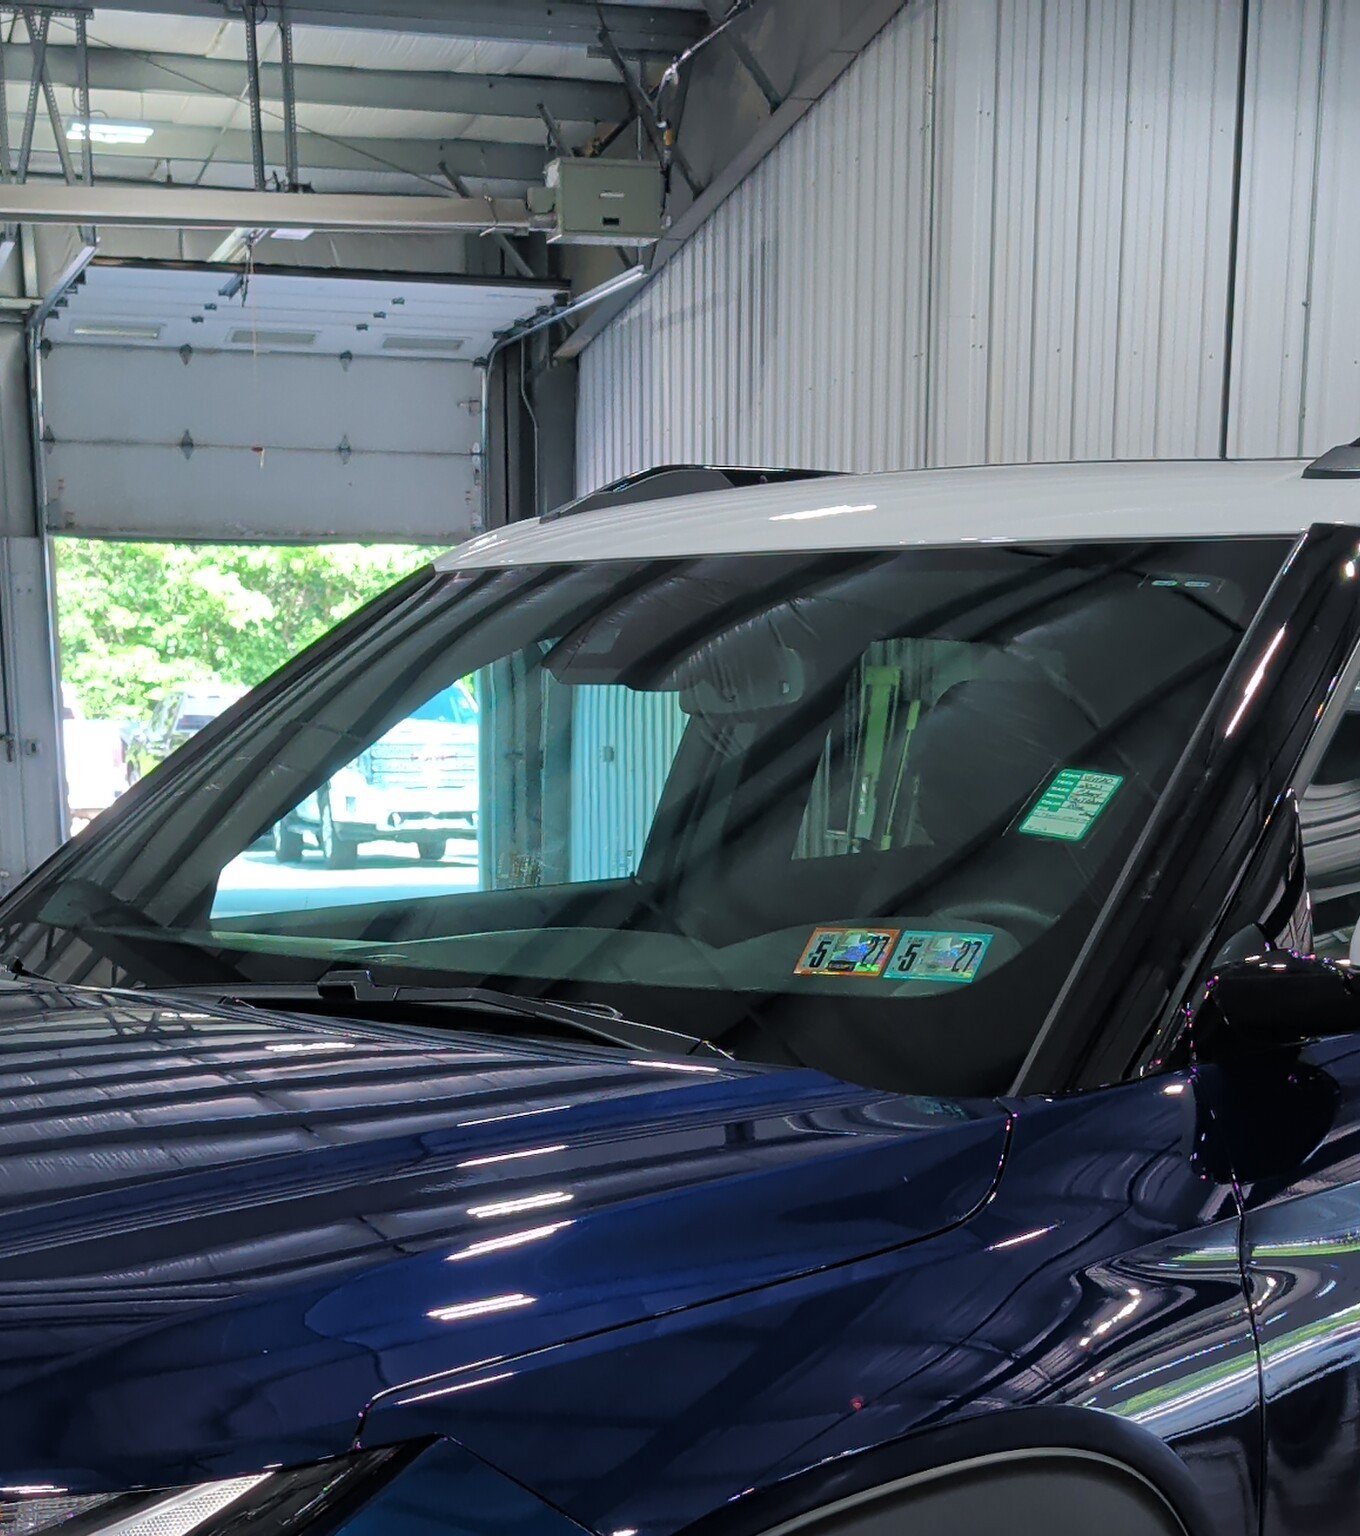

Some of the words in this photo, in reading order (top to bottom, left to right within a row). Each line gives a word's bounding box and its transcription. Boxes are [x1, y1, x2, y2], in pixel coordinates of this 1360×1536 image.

[808, 940, 832, 968] 5
[861, 936, 891, 967] 27
[898, 942, 922, 972] 5
[951, 940, 983, 973] 27
